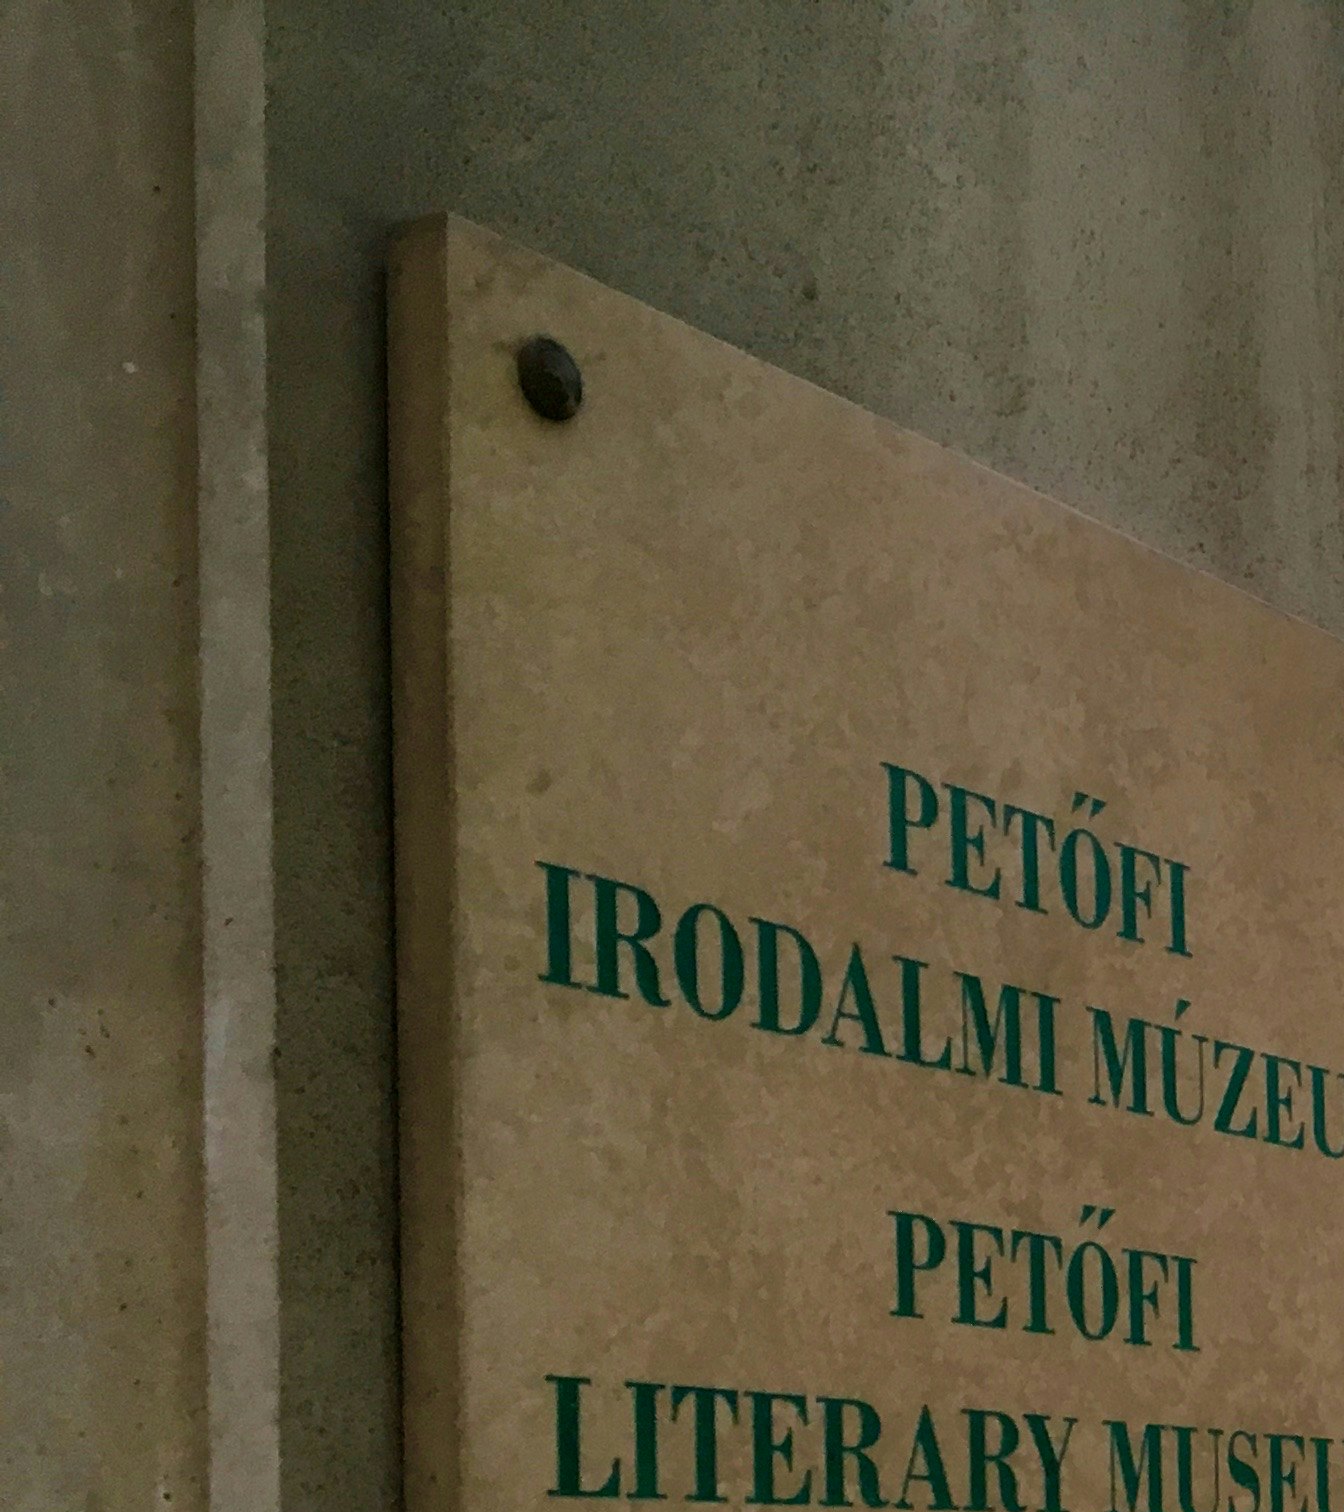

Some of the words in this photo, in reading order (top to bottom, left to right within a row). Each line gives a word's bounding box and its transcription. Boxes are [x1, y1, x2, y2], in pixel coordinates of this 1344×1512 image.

[879, 761, 1192, 959] PETŐFI
[535, 860, 1063, 1097] IRODALMI
[888, 1205, 1201, 1353] PETŐFI
